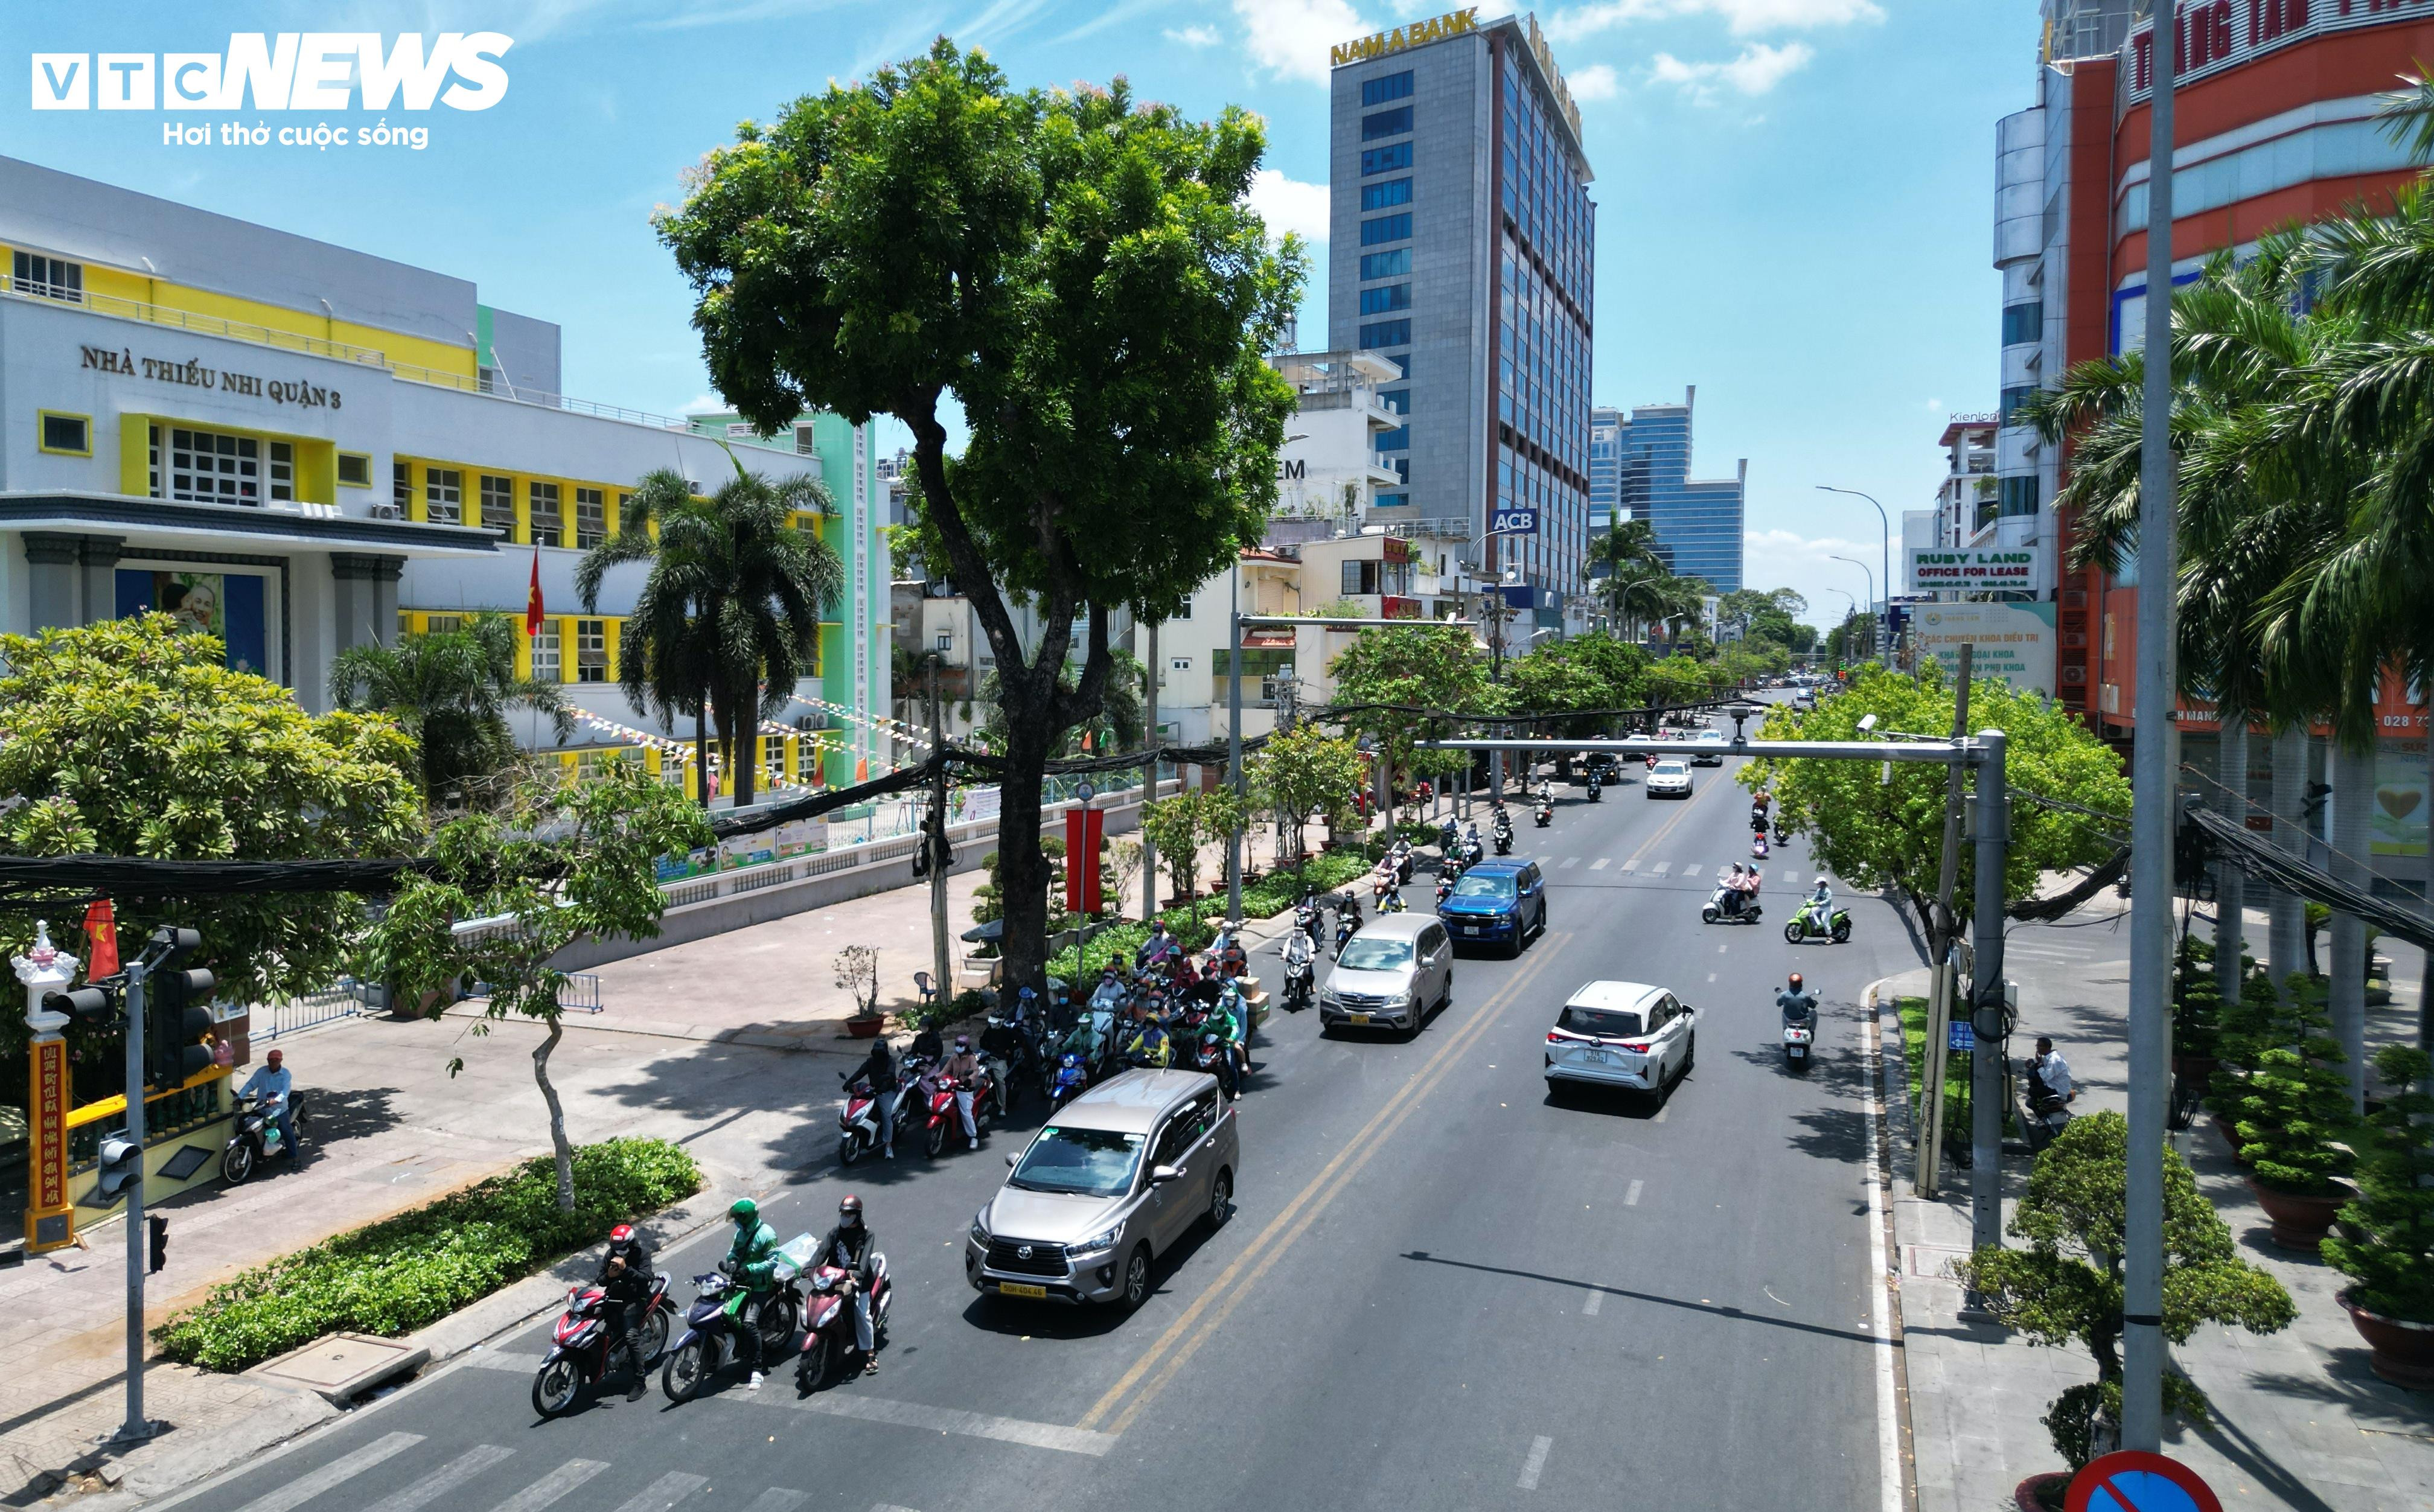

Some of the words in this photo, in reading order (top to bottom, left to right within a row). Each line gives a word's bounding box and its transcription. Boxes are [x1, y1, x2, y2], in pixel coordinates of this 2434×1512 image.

[1330, 33, 1384, 66] NAM
[1409, 7, 1479, 46] BANK
[2133, 0, 2231, 91] TÁNG
[80, 346, 136, 376] NHÀ
[142, 357, 216, 389] THIẾU
[221, 372, 263, 397] NHI
[268, 380, 327, 409] QUẬN
[330, 391, 342, 409] 3
[1493, 513, 1533, 530] ACB
[1916, 553, 1970, 564] RUBY
[1977, 553, 2031, 564] LAND
[1918, 567, 1960, 577] OFFICE
[1963, 567, 1987, 576] FOR
[1990, 567, 2029, 576] LEASE
[1944, 633, 1976, 643] CHUYÊN
[2025, 634, 2039, 643] TRỊ
[1972, 651, 1990, 660] GOẠI
[1993, 650, 2015, 659] KHOA
[2384, 715, 2409, 727] 028
